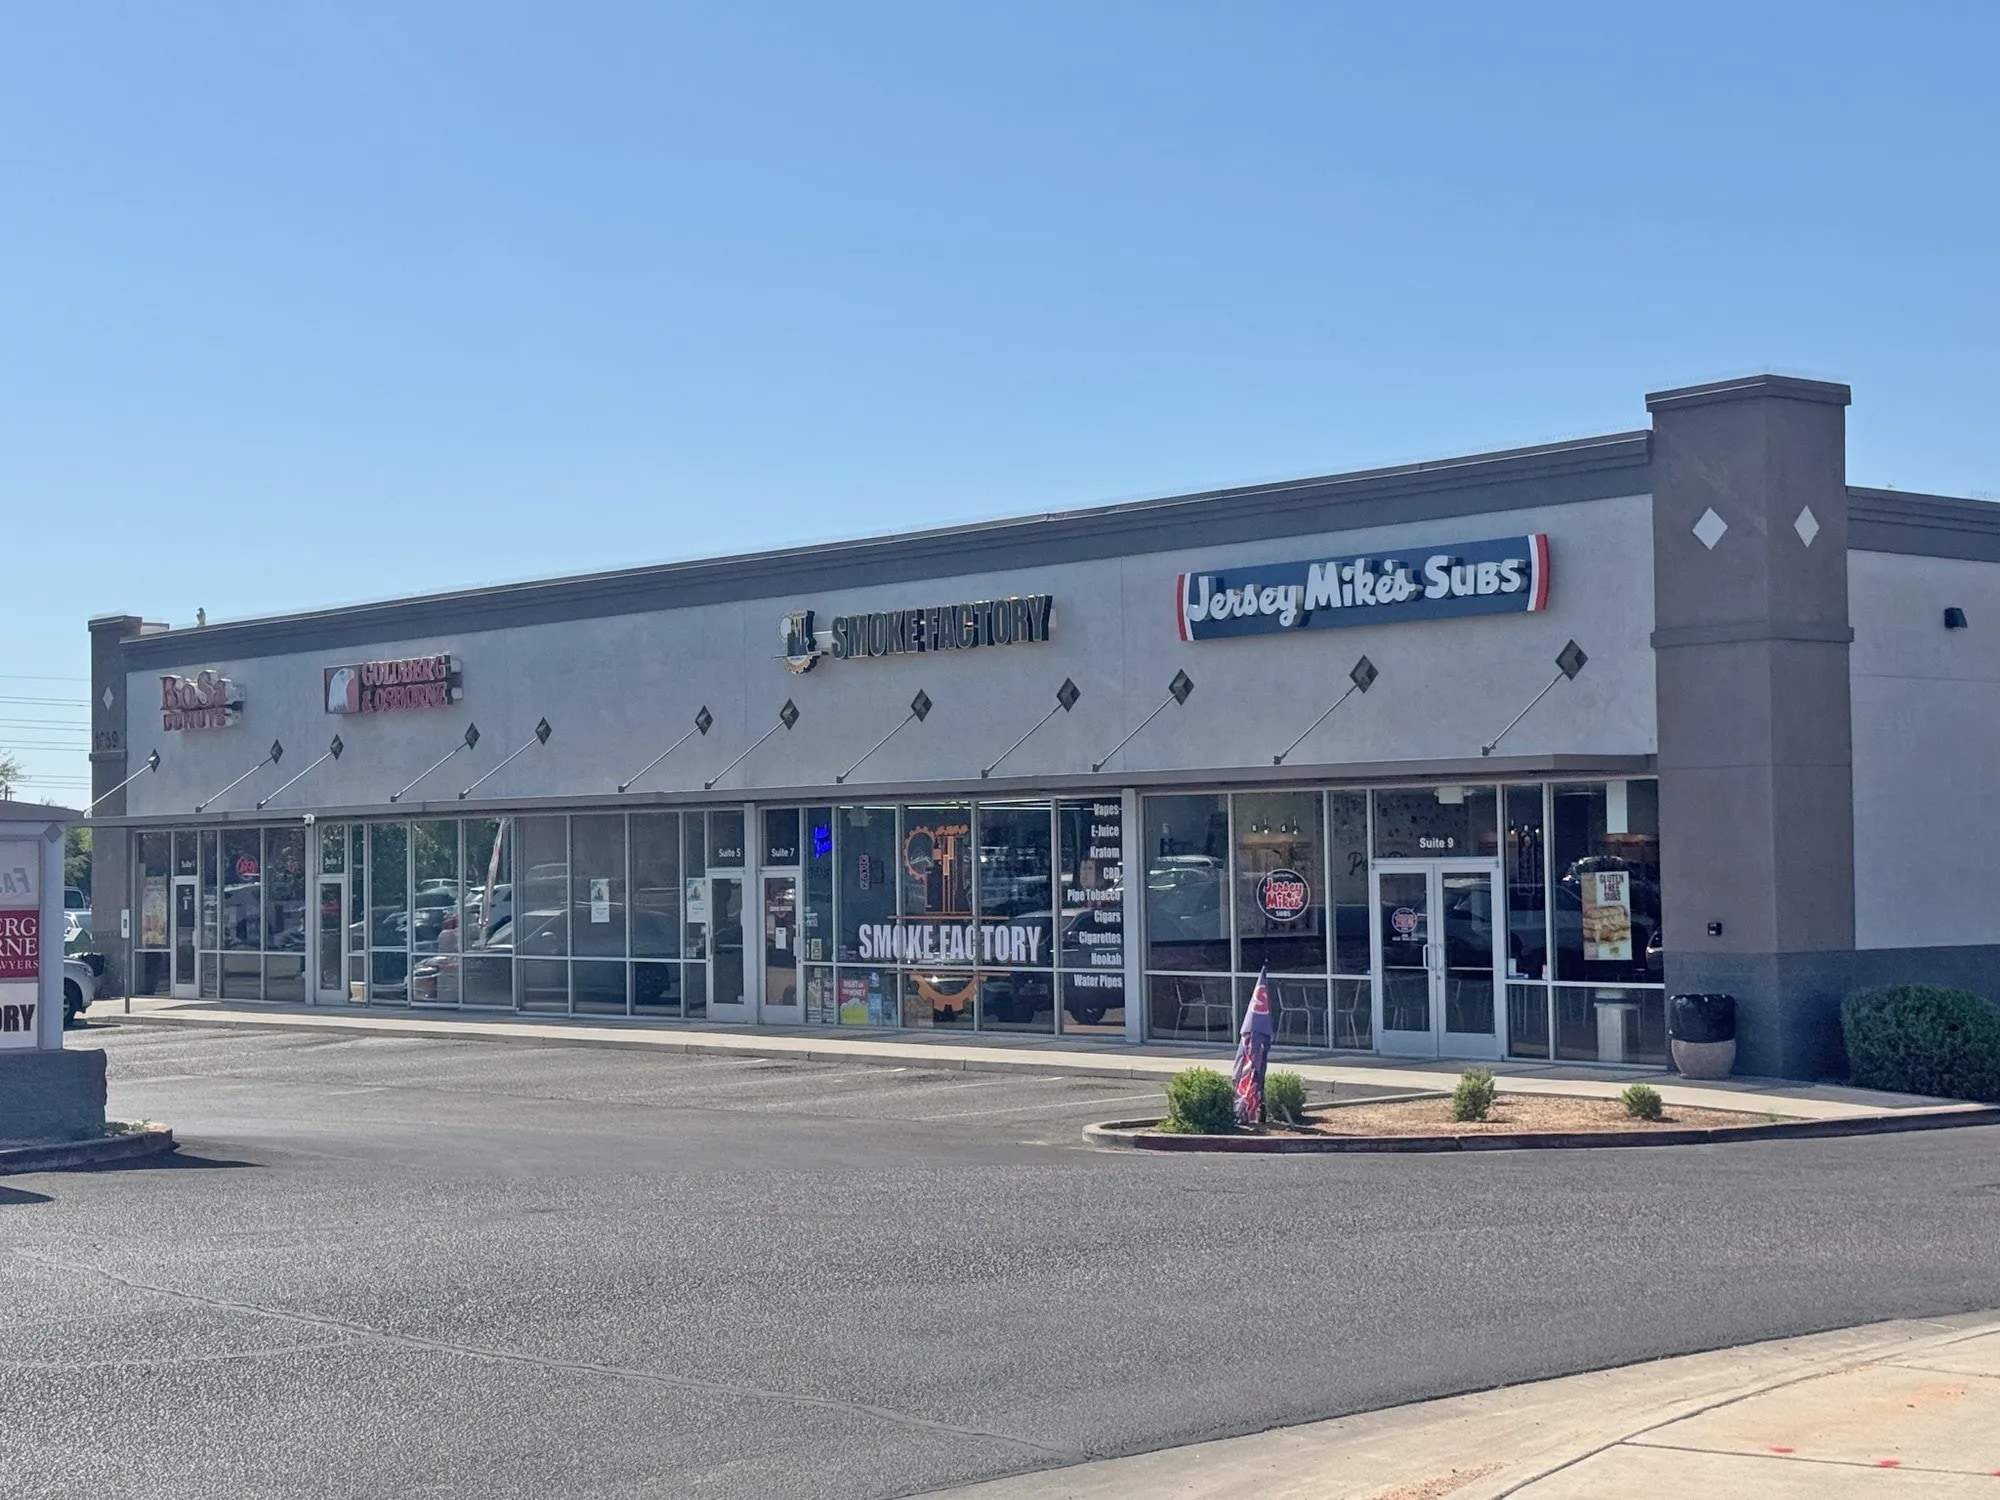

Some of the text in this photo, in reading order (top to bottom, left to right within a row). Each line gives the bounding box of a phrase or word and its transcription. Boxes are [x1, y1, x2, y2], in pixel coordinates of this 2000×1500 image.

[1187, 576, 1302, 627] Jersey
[1305, 558, 1421, 611] Mike's
[831, 595, 1049, 660] SMOKE FACTORY
[362, 655, 446, 686] GOLDBERG
[374, 682, 447, 712] OSBORNE
[163, 708, 227, 731] DONUTS
[1093, 803, 1119, 817] Vapes
[1091, 824, 1119, 837] E-Juice
[1419, 837, 1454, 848] Suite 9
[718, 848, 737, 857] Suite
[771, 848, 794, 857] Suite 7
[1090, 846, 1120, 859] Kratom
[1103, 867, 1120, 880] CBD
[1599, 873, 1624, 884] GLUTEN
[1263, 878, 1304, 899] Jersey
[1067, 889, 1121, 902] Pipe Tobacco
[1094, 910, 1121, 923] Cigars
[859, 923, 1041, 963] SMOKE FACTORY
[1079, 932, 1121, 945] Cigarettes
[1091, 953, 1122, 965] Hookah
[1074, 974, 1123, 988] Water Pipes
